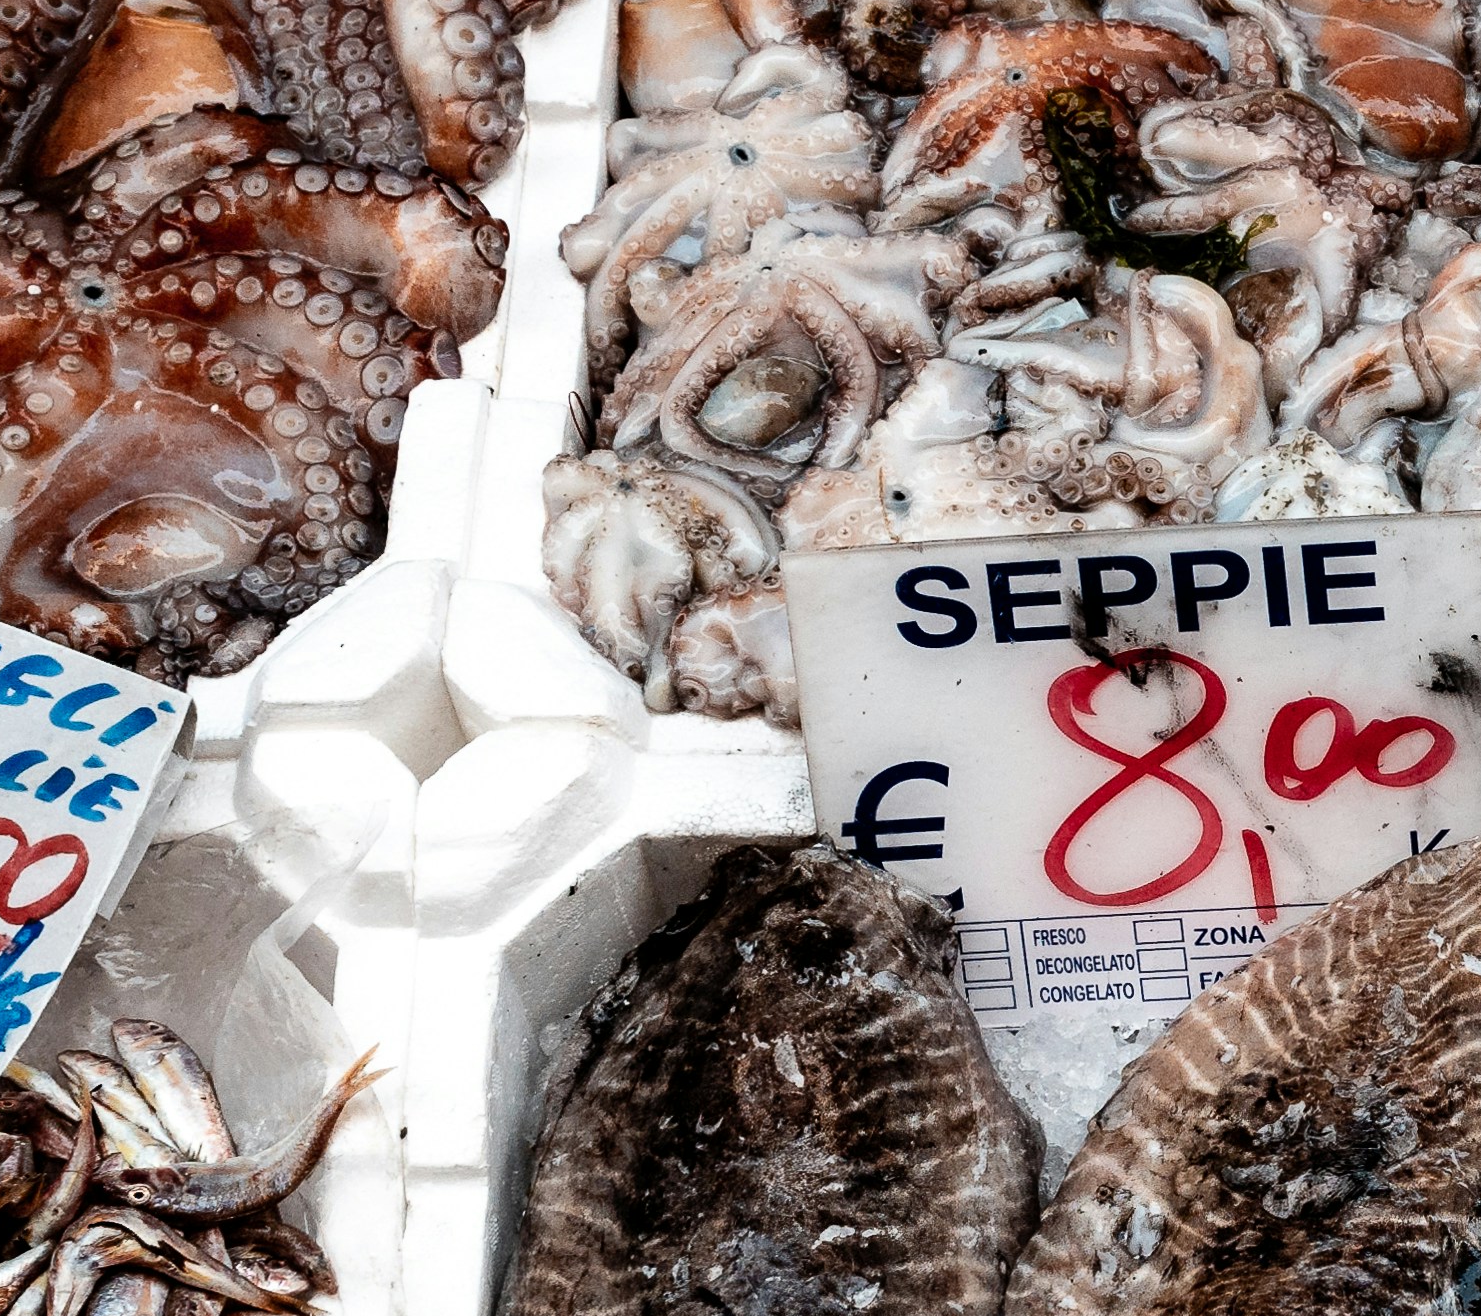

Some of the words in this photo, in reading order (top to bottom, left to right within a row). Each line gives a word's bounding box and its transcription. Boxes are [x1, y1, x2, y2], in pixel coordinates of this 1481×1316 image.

[895, 540, 1385, 650] SEPPIE
[1033, 928, 1086, 946] FRESCO
[1194, 925, 1266, 946] ZONA
[1035, 954, 1135, 975] DECONGELATO
[1040, 982, 1134, 1003] CONGELATO
